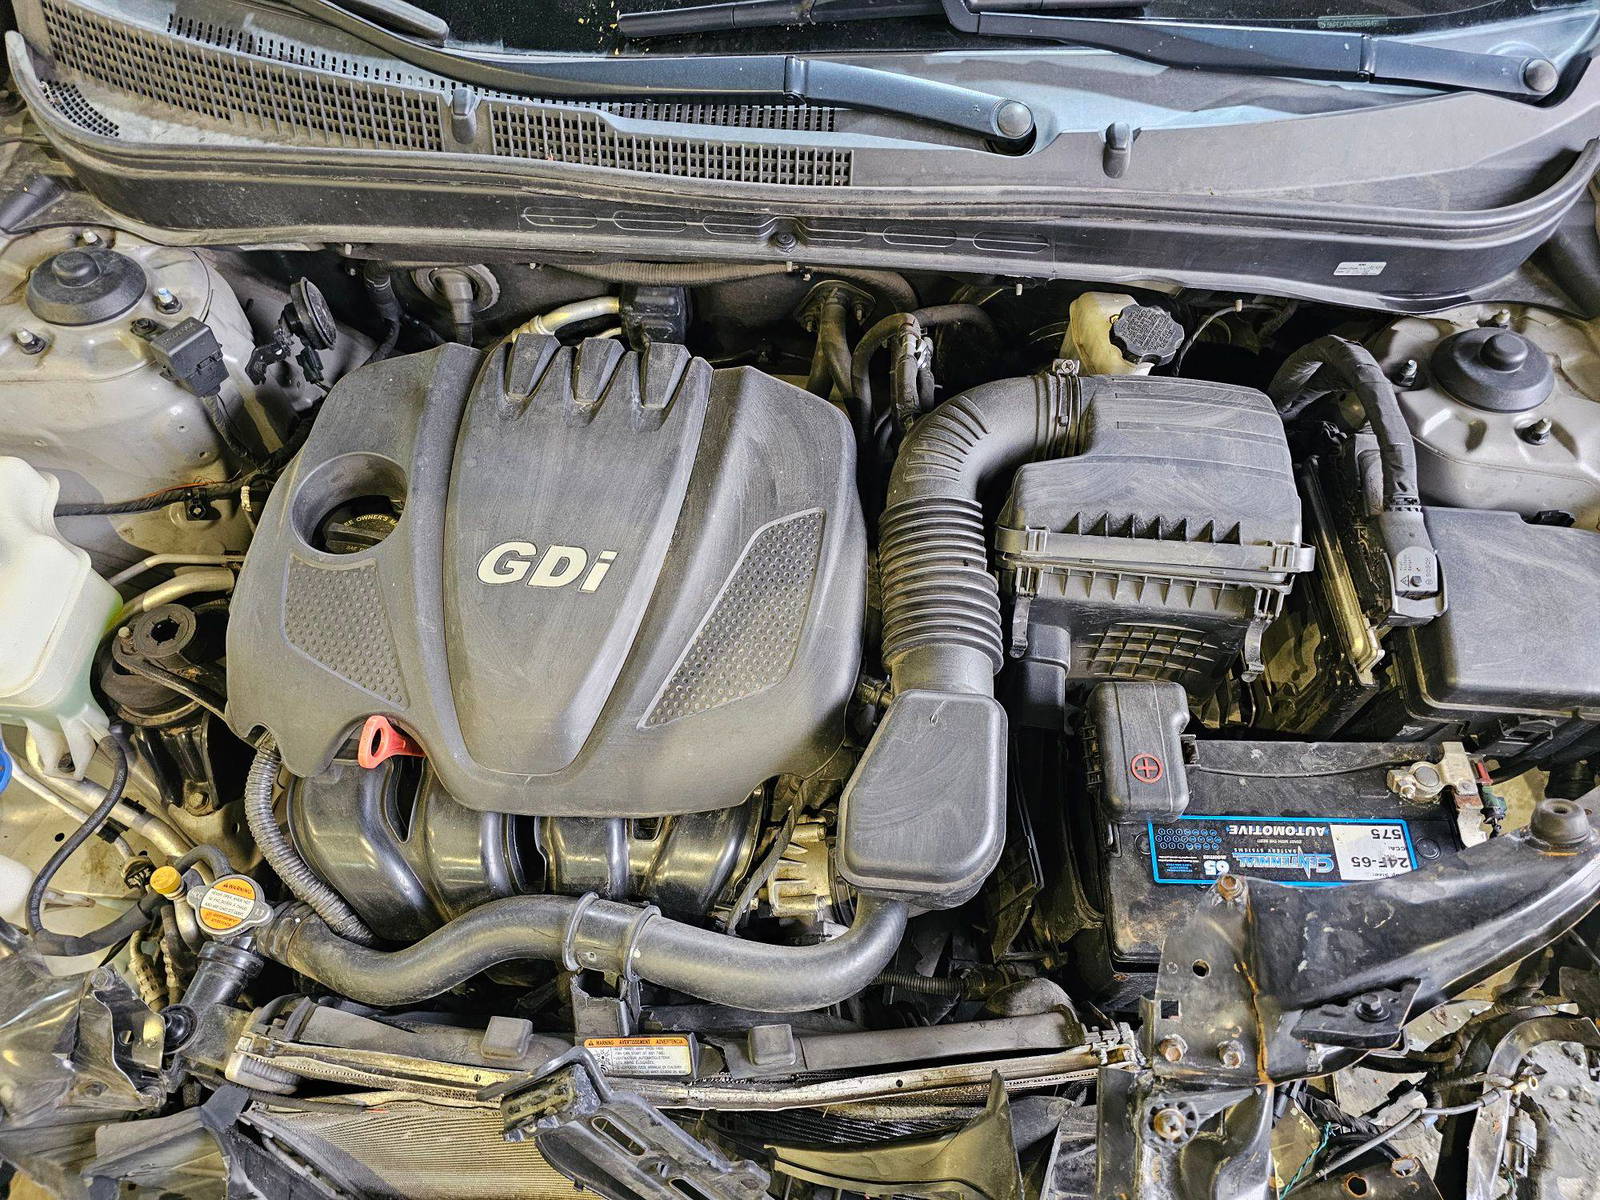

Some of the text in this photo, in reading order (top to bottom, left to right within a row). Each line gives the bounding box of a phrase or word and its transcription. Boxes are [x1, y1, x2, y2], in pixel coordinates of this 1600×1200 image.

[356, 514, 389, 522] OWNER'S
[477, 541, 619, 593] GDi
[1229, 823, 1327, 837] AUTOMOTIVE
[1370, 828, 1402, 840] 575
[1203, 859, 1230, 876] 65
[1351, 856, 1410, 869] 24F-65
[228, 883, 253, 895] WARNING
